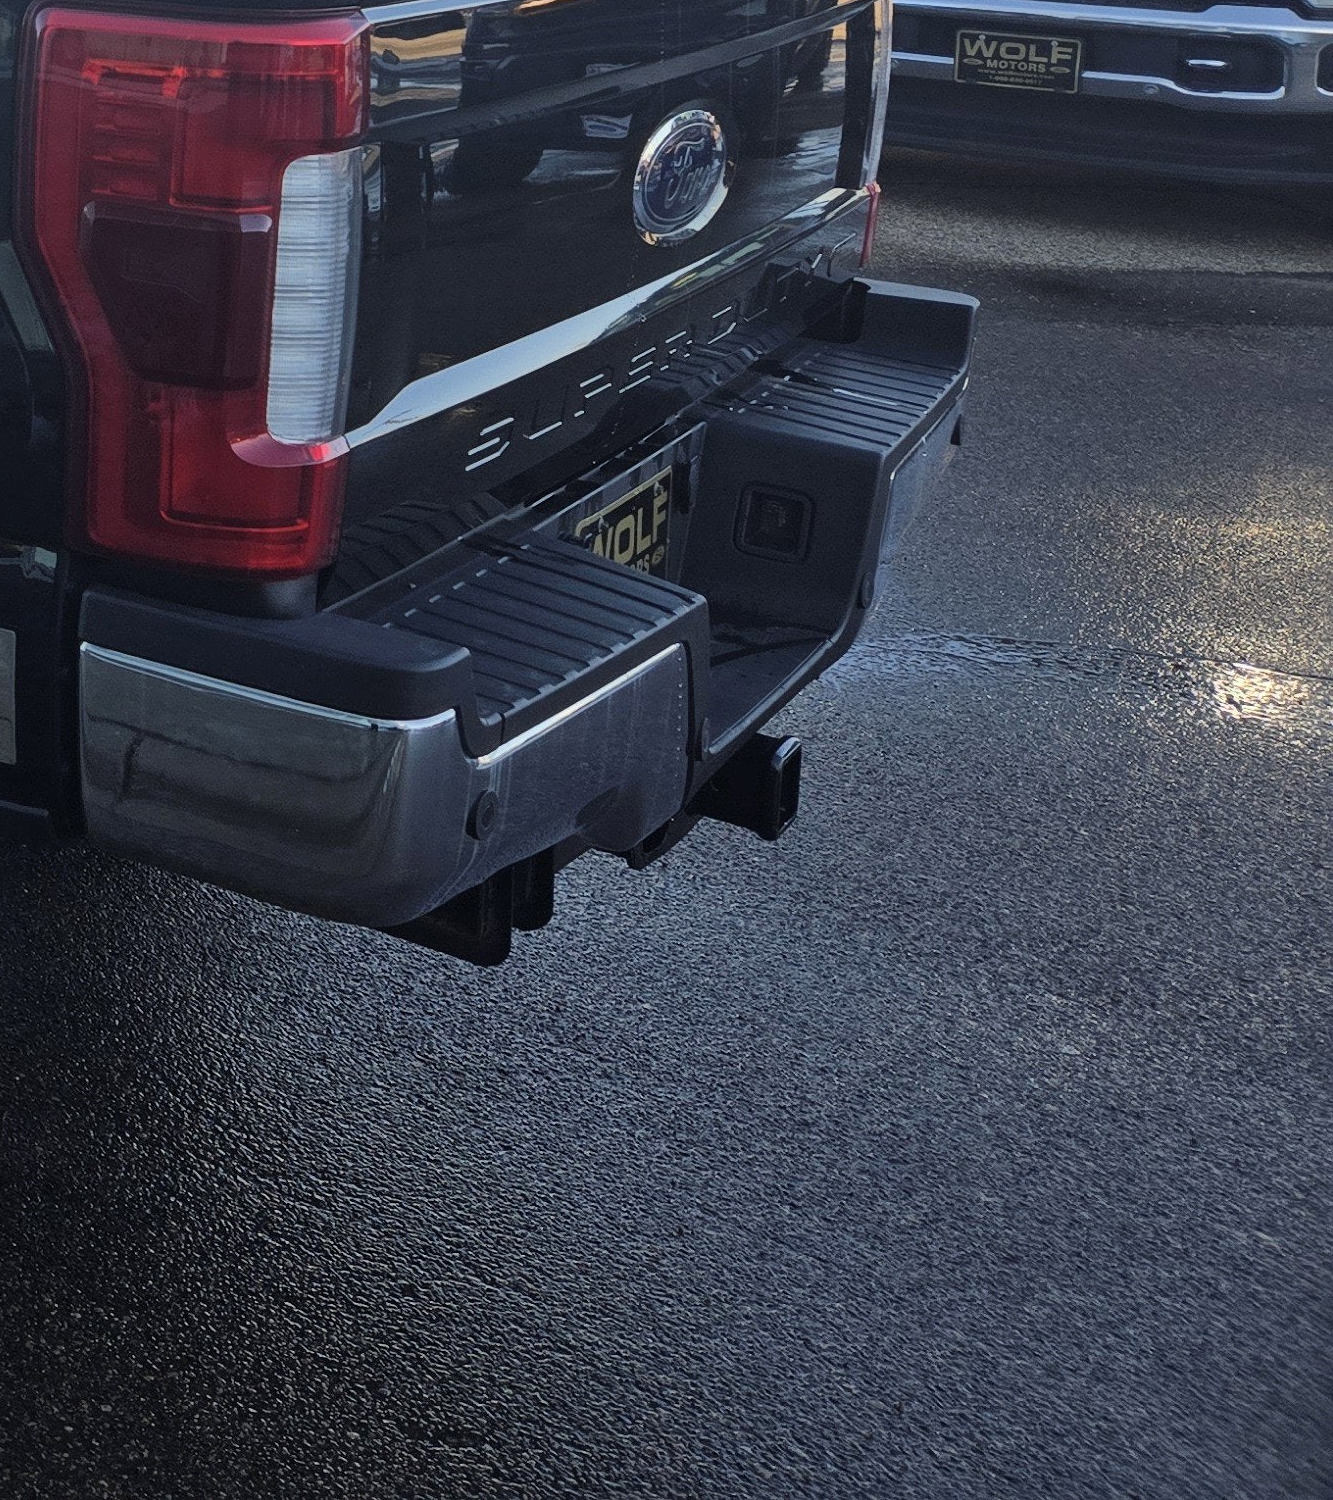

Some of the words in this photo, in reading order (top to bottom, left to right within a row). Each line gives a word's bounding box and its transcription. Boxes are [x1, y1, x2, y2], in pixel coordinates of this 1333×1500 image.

[963, 37, 1073, 64] WOLF
[986, 59, 1046, 73] MOTORS
[663, 137, 720, 209] Ford
[464, 329, 695, 472] SUPER
